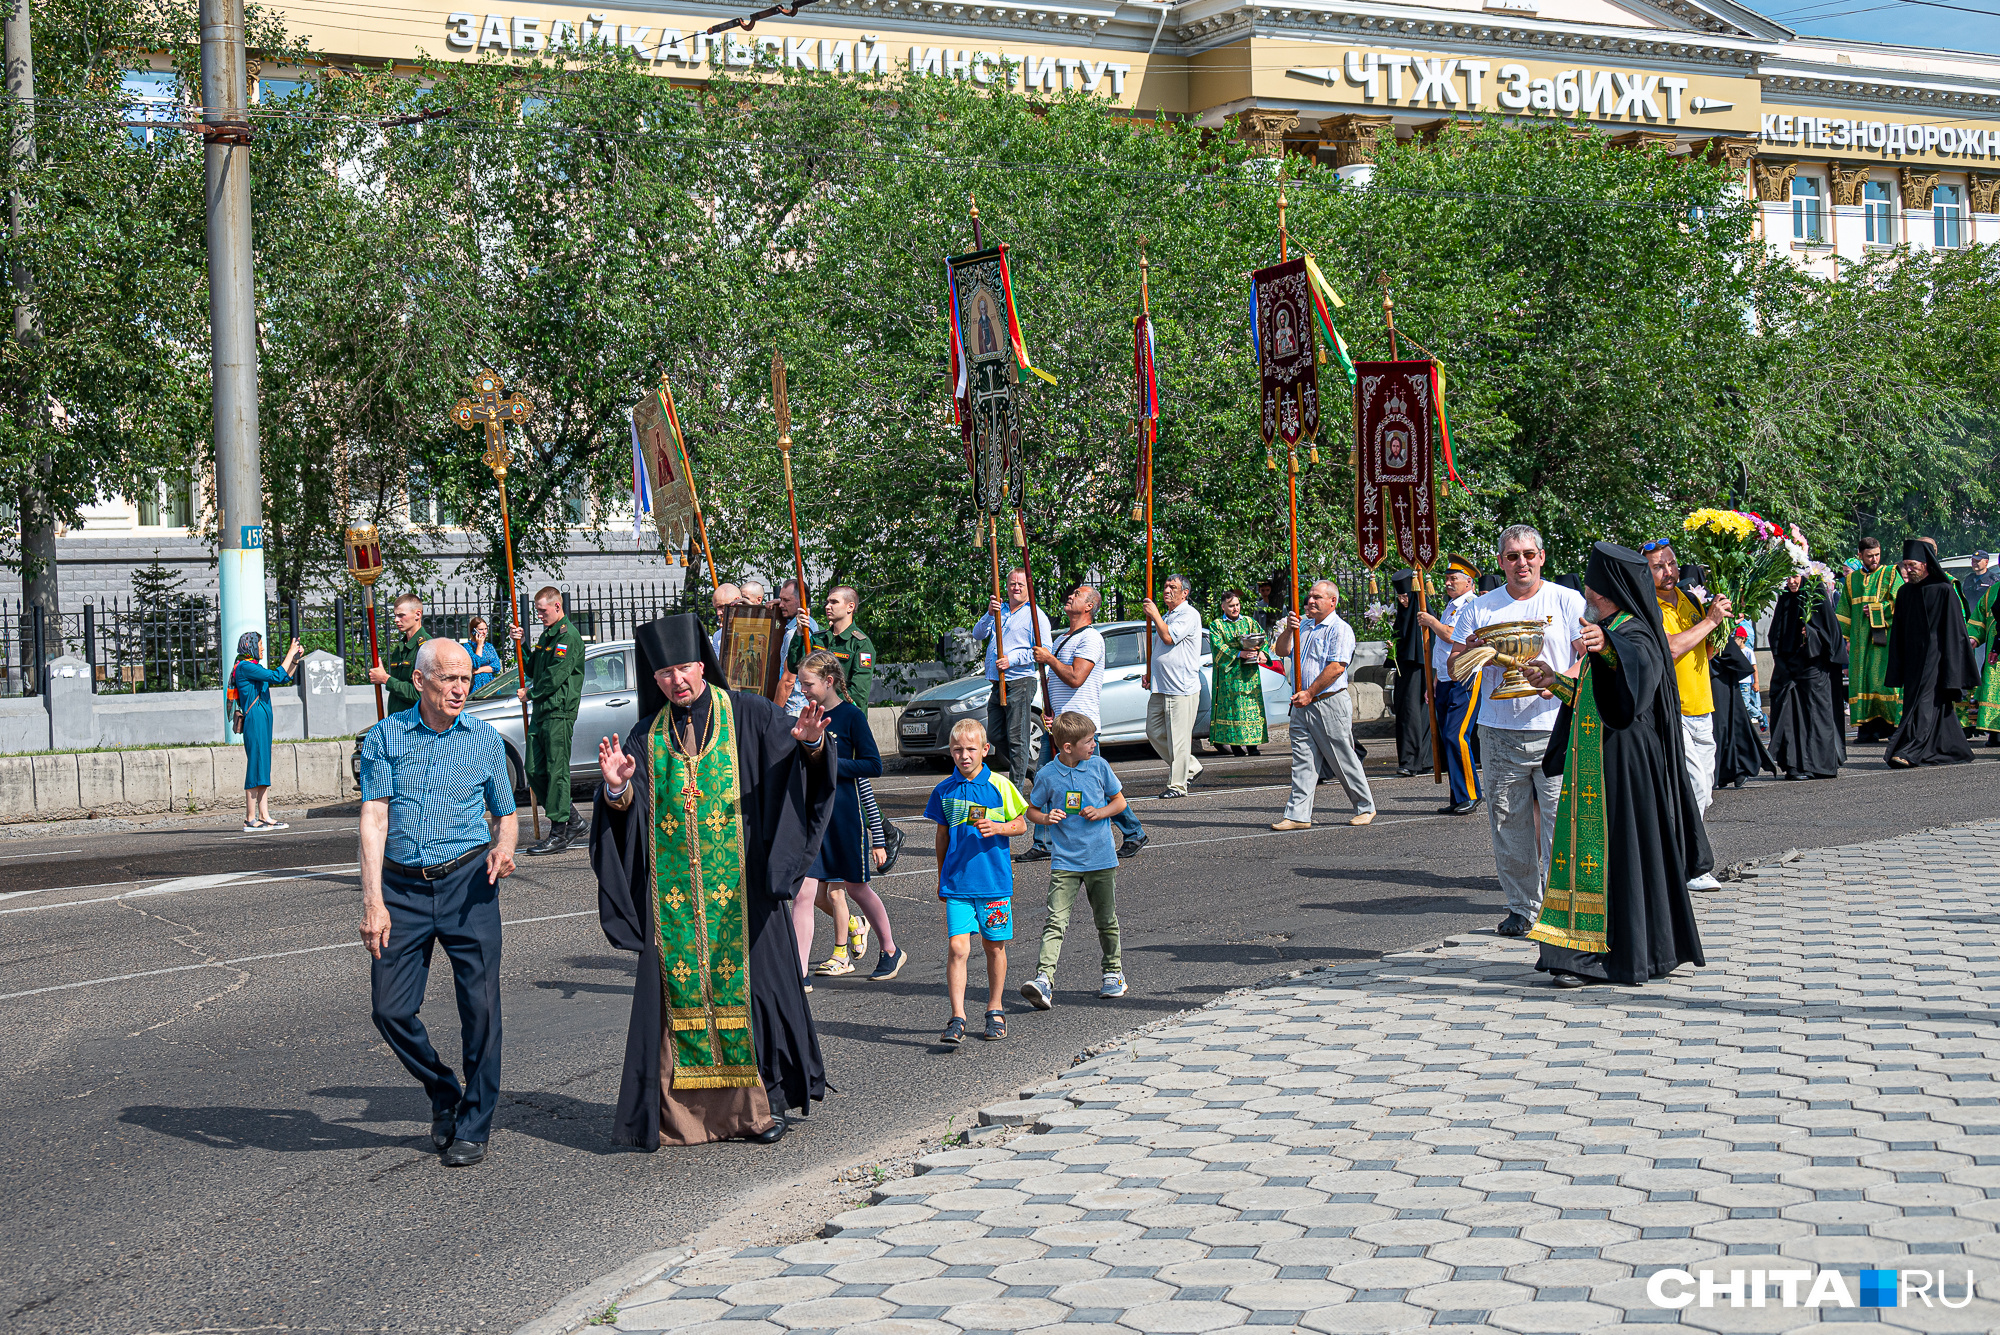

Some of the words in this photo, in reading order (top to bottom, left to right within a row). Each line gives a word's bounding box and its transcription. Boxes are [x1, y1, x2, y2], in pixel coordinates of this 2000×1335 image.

[446, 12, 888, 76] ЗАБАЙКАЛЬСКИЙ
[909, 46, 1131, 94] ИНСТИТУТ
[1344, 51, 1491, 105] ЧТЖТ
[1497, 63, 1689, 120] ЗабИЖТ
